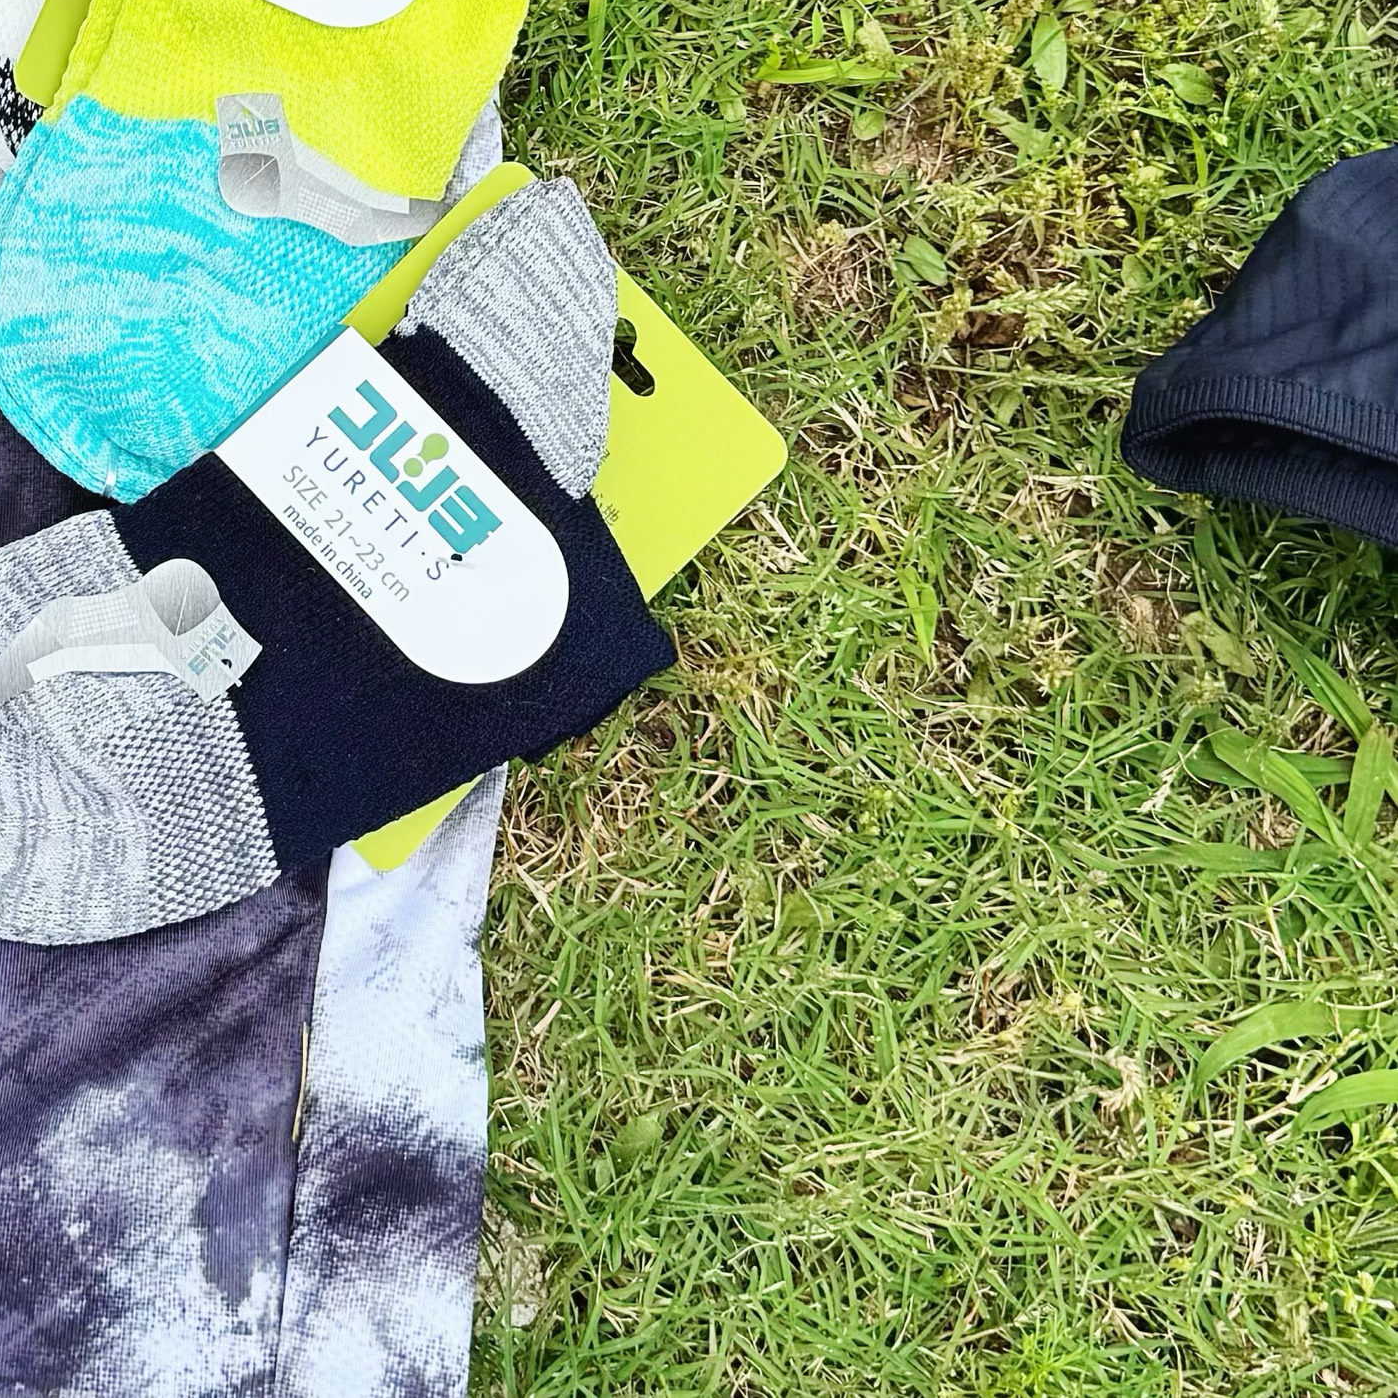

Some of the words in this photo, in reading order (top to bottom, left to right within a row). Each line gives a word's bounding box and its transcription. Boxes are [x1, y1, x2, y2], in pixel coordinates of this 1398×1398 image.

[282, 465, 329, 511] SIZE
[324, 509, 386, 572] 21~23
[381, 570, 411, 603] cm
[282, 503, 323, 547] made
[320, 540, 338, 563] in
[336, 556, 374, 600] china
